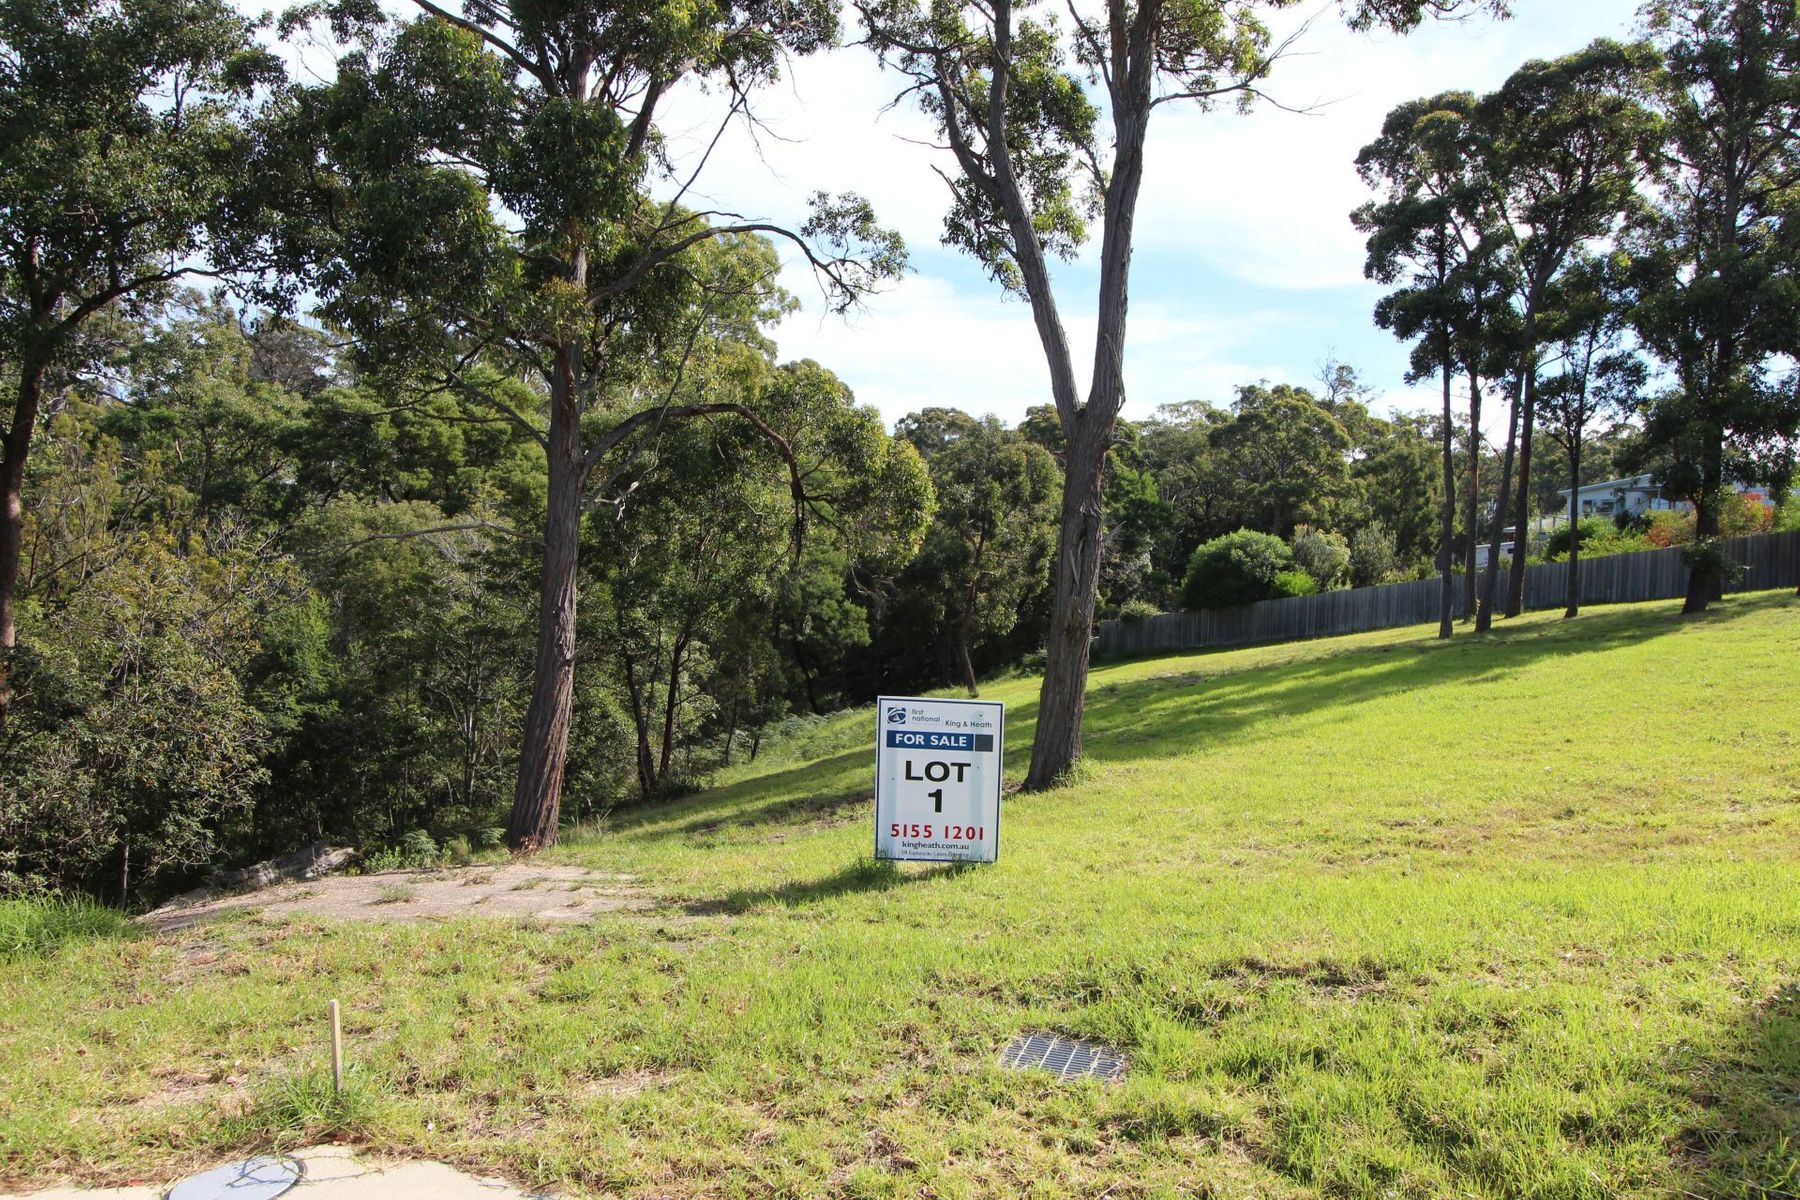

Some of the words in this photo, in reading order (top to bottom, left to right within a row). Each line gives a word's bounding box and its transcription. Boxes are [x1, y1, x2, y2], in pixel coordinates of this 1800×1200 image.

[945, 720, 961, 728] King
[895, 734, 925, 745] FOR
[930, 735, 967, 747] SALE
[905, 760, 971, 782] LOT
[928, 788, 943, 813] 1
[890, 823, 932, 838] 5155
[944, 825, 984, 840] 1201
[902, 841, 969, 850] kingheath.com.au
